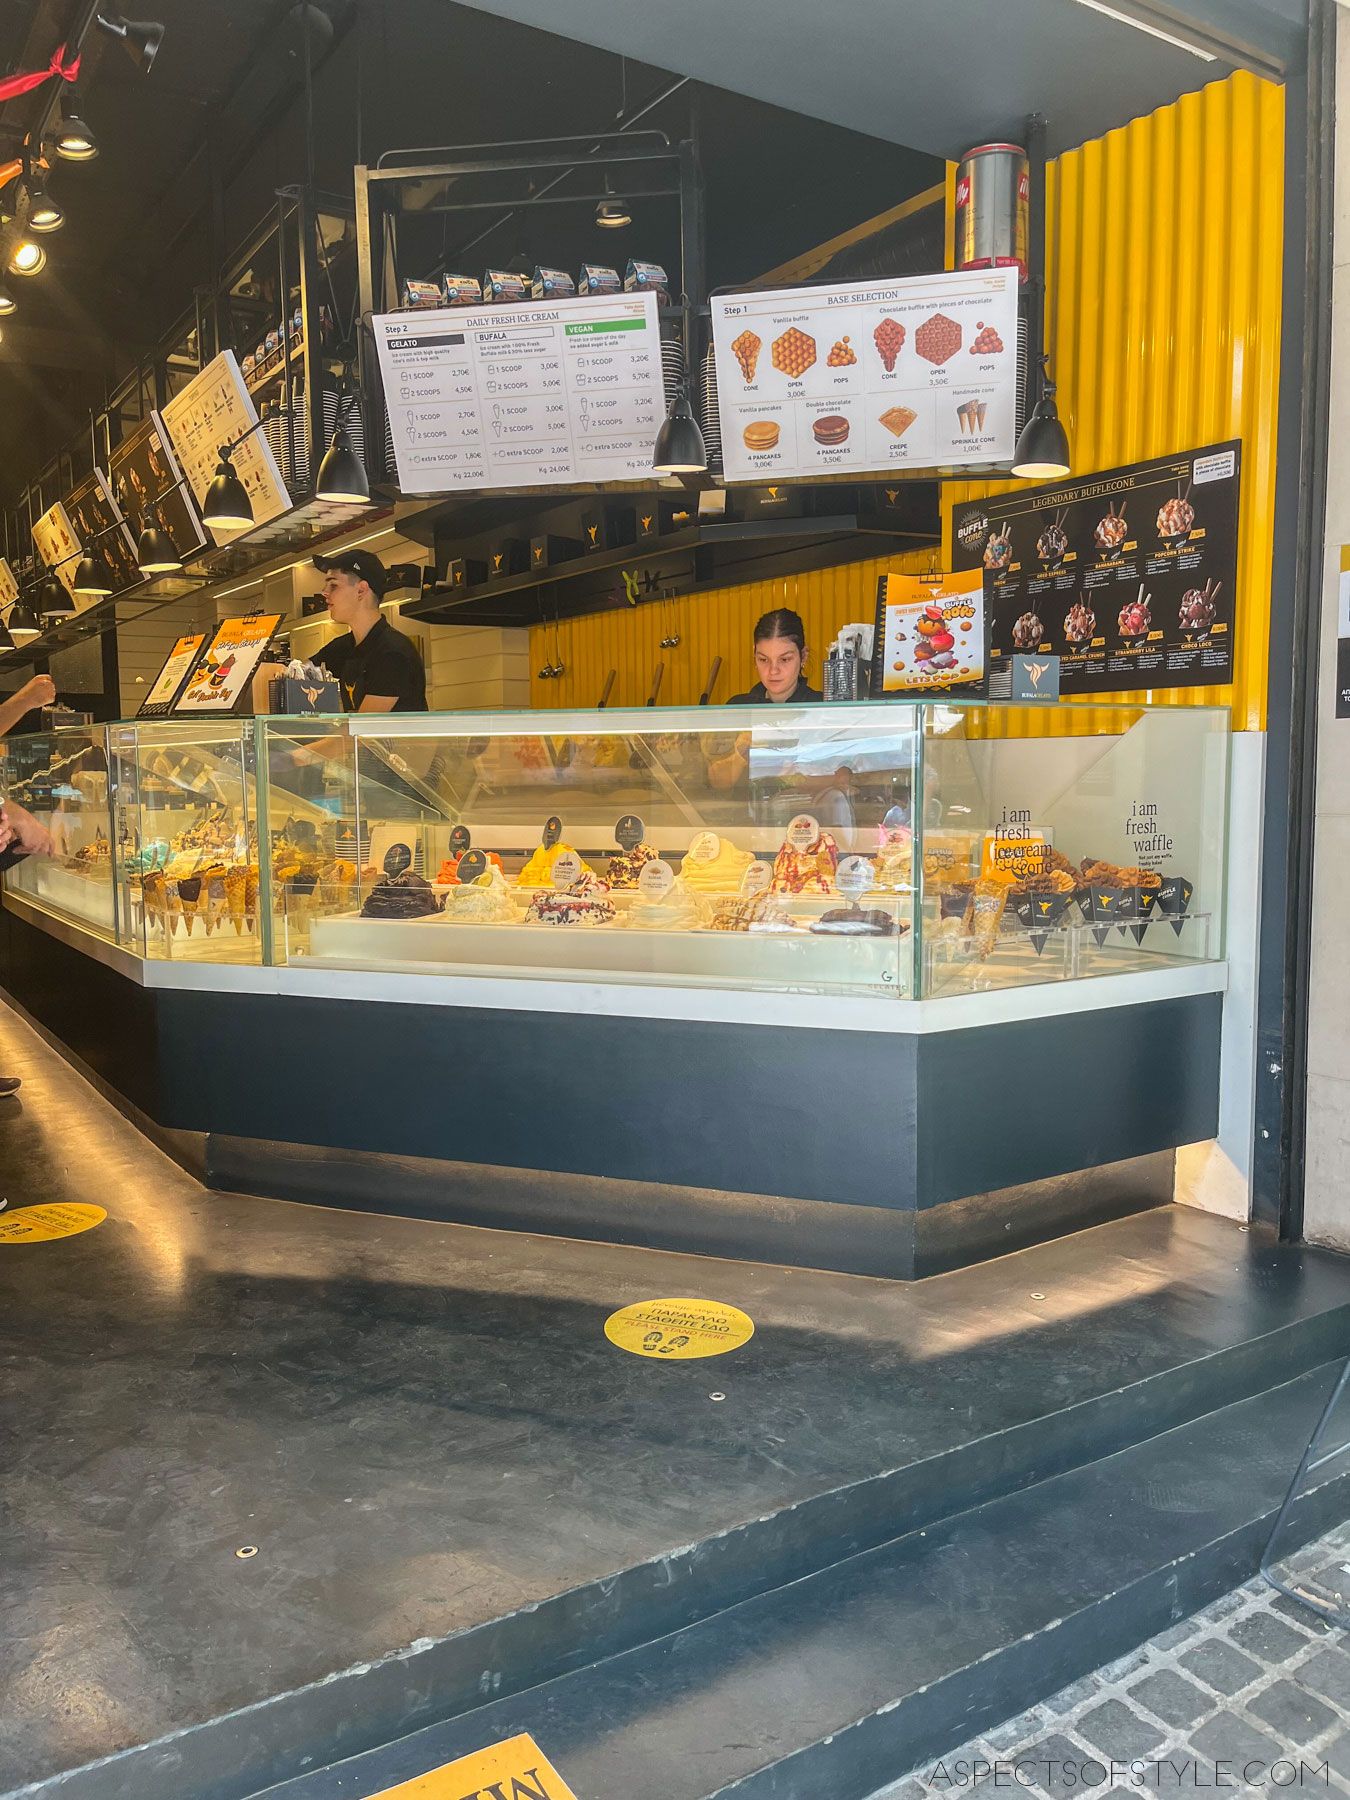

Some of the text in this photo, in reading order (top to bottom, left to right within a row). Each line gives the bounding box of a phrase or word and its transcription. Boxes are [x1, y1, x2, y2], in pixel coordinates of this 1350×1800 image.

[827, 291, 898, 305] BASE SELECTION
[880, 306, 907, 314] Chocolate
[939, 301, 957, 309] pieces
[965, 298, 992, 306] chocolate
[724, 307, 741, 315] Step
[466, 312, 560, 327] DAILY FRESH ICE CREAM
[385, 326, 401, 334] Step
[569, 325, 593, 334] VEGAN
[480, 332, 507, 341] BUFALA
[391, 340, 418, 348] GELATO
[631, 355, 649, 363] 3,20€
[502, 365, 523, 373] SCOOP
[541, 362, 559, 370] 3,00€
[452, 369, 470, 377] 2,70€
[632, 372, 651, 380] 5,70€
[542, 380, 561, 388] 5,00€
[929, 378, 948, 386] 3,50€
[416, 389, 441, 397] SCOOPS
[455, 386, 473, 394] 4,50€
[787, 390, 806, 398] 3,00€
[952, 388, 980, 396] Handmade
[596, 400, 617, 408] SCOOP
[634, 398, 653, 406] 3,20€
[546, 404, 564, 412] 3,00€
[758, 405, 782, 413] pancakes
[816, 406, 841, 414] pancakes
[458, 411, 476, 419] 2,70€
[636, 416, 654, 424] 5,70€
[548, 422, 566, 430] 5,00€
[423, 431, 447, 439] SCOOPS
[461, 428, 479, 436] 4,50€
[611, 442, 633, 450] SCOOP
[951, 438, 979, 446] SPRINKLE
[523, 448, 544, 456] SCOOP
[551, 446, 569, 454] 2,00€
[963, 444, 982, 452] 1,00€
[465, 452, 482, 460] 1,80€
[752, 453, 781, 461] PANCAKES
[889, 450, 908, 458] 2,50€
[823, 456, 841, 464] 3,50€
[549, 465, 570, 473] 24,00€
[754, 461, 773, 469] 3,00€
[453, 471, 484, 480] Kg 22,00€
[1032, 478, 1135, 509] LEGENDARY BUFFLECONE
[958, 518, 989, 539] BUFFLE
[964, 531, 983, 544] cone
[1154, 547, 1196, 558] POPCORN STRIKE
[1095, 560, 1125, 569] BANANARAMA
[945, 598, 973, 609] BUFFLE
[942, 605, 976, 621] POPS
[1181, 642, 1198, 650] CHOCO
[1115, 648, 1145, 656] STRAWBERRY
[932, 673, 960, 682] POP
[1132, 800, 1158, 817] i am
[1002, 806, 1031, 823] i am
[1126, 818, 1157, 835] fresh
[994, 823, 1031, 842] fresh
[1133, 834, 1173, 853] waffle
[994, 843, 1011, 860] ice
[1013, 843, 1052, 858] cream
[1020, 861, 1053, 875] cone
[1157, 887, 1176, 898] BUFFLE
[651, 1308, 727, 1325] ΠΑΡΑΚΑΛΩ
[636, 1313, 730, 1333] ΣΤΑΘΕΙΤΕ ΕΔΩ
[624, 1320, 727, 1341] PLEASE STAND HERE
